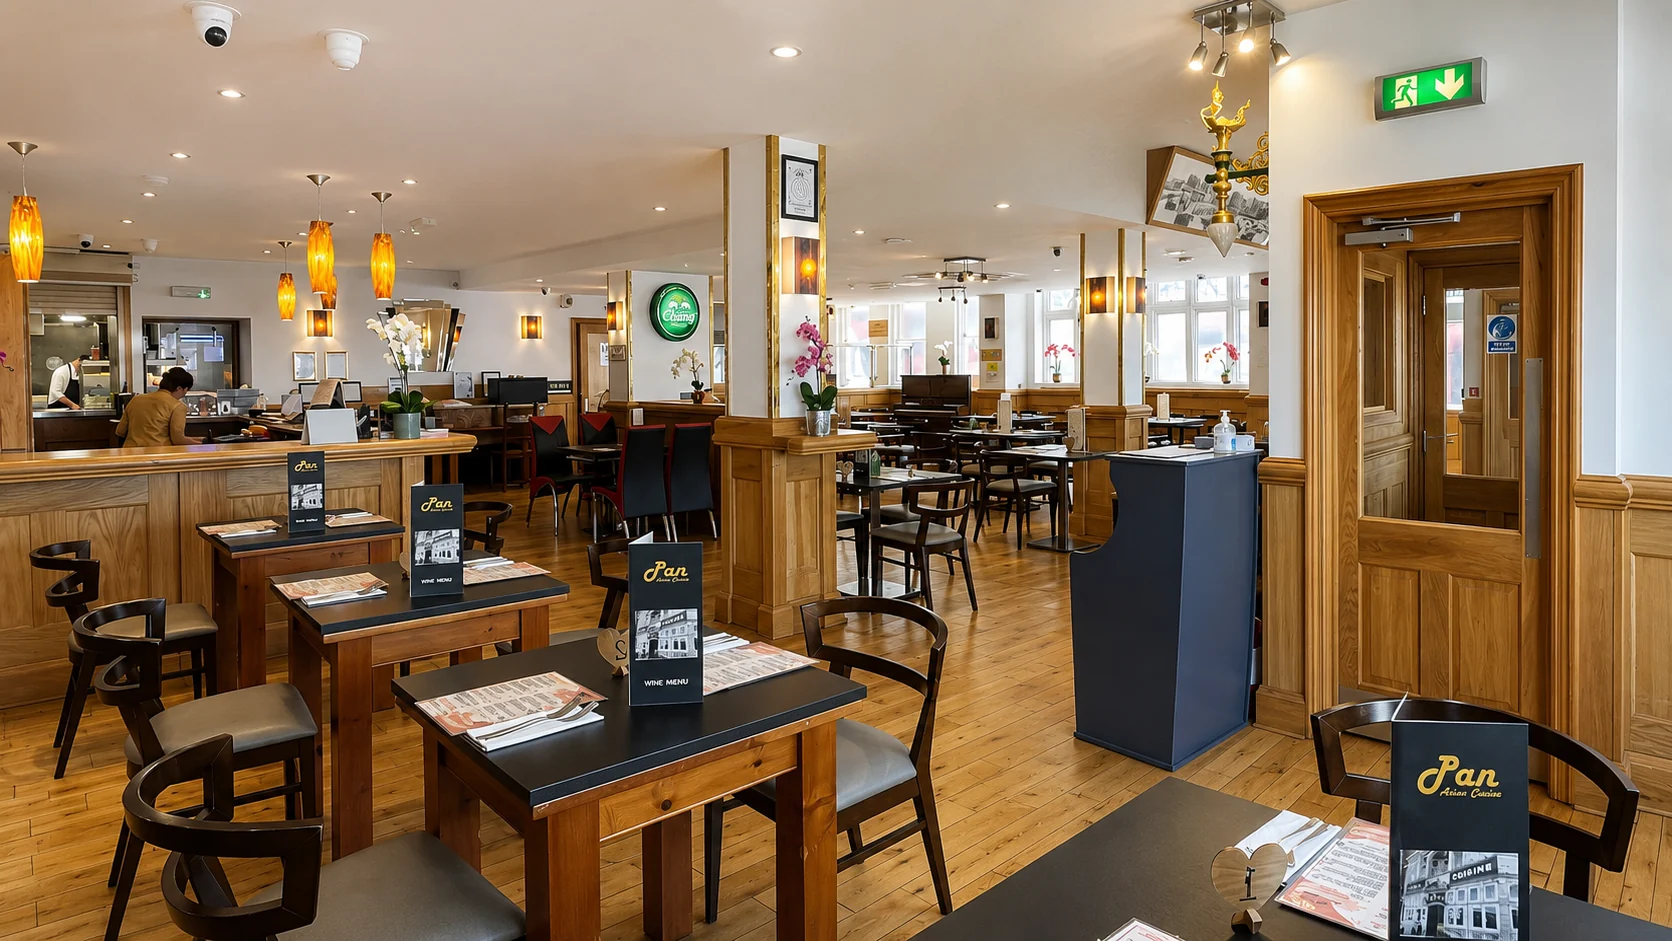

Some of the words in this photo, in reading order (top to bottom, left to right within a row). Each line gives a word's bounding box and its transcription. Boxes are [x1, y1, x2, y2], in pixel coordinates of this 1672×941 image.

[663, 309, 694, 325] Chang
[421, 496, 453, 512] Pan
[643, 561, 688, 582] Pan
[665, 678, 689, 686] MENU
[1417, 754, 1499, 795] Pan
